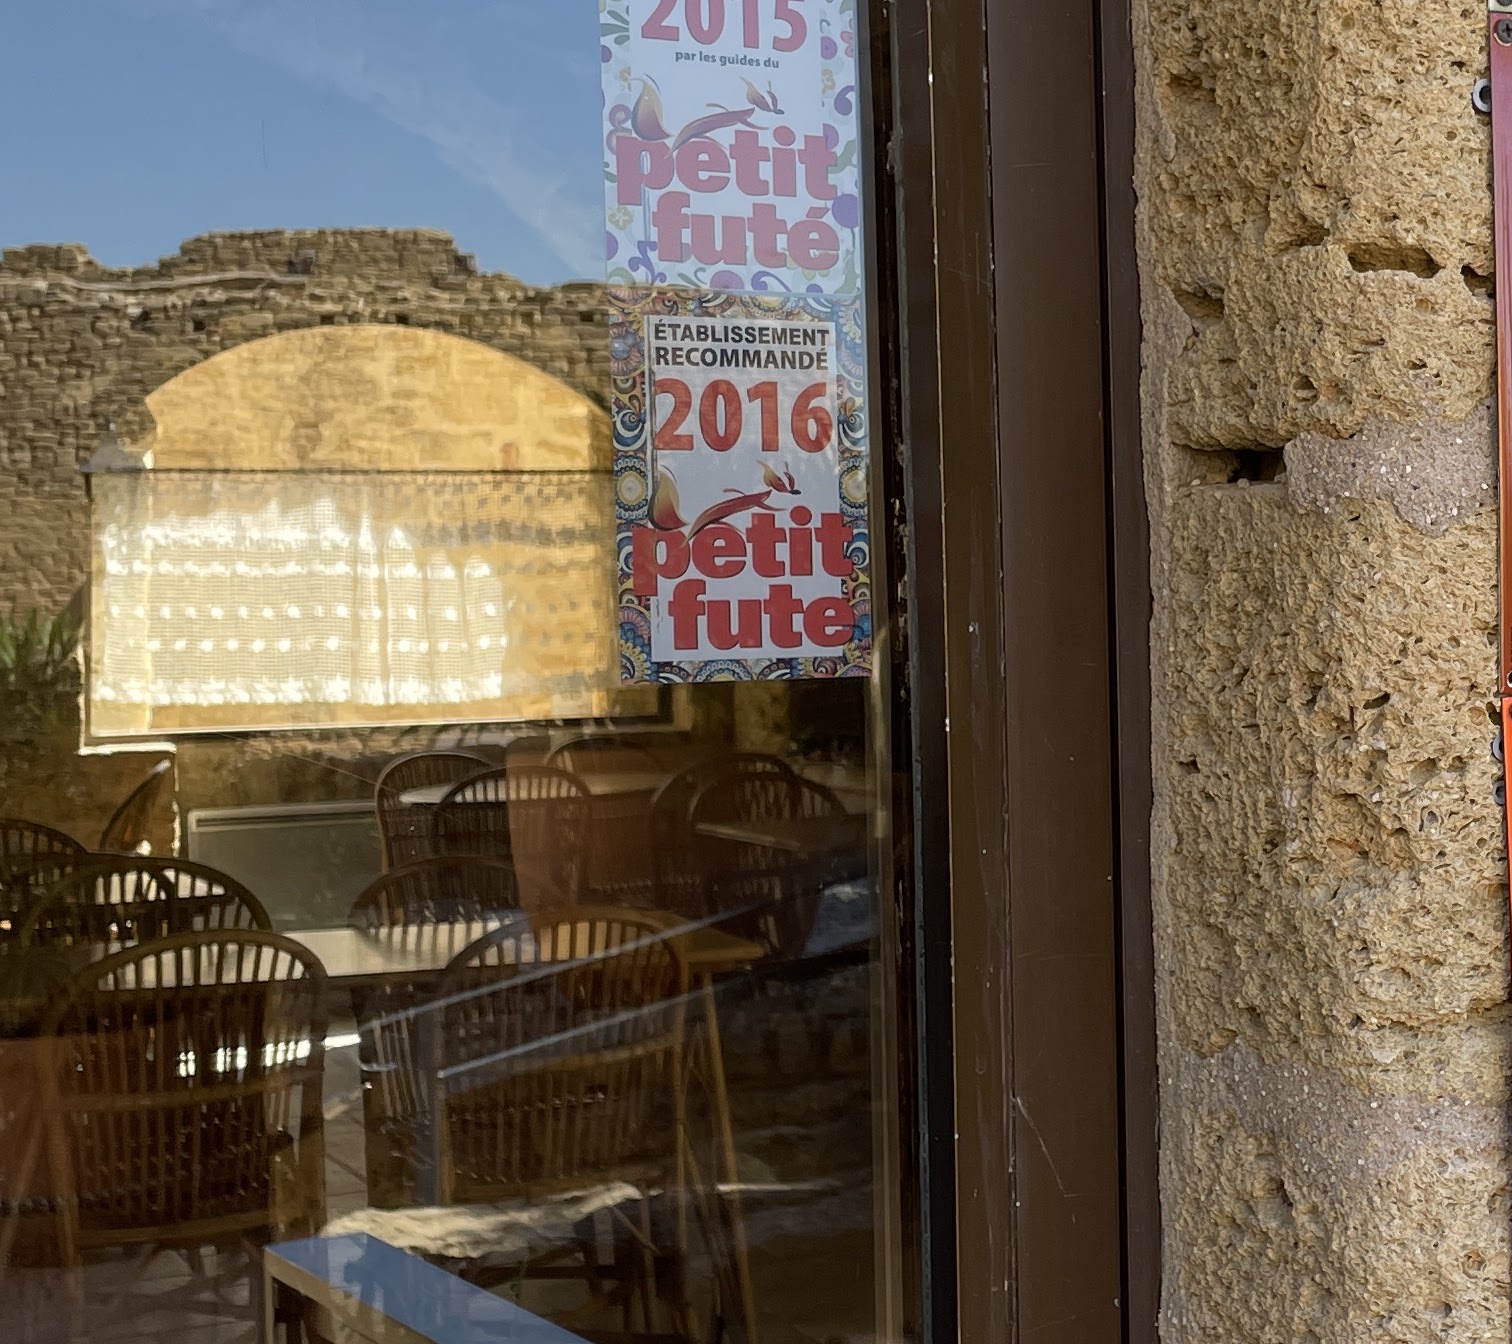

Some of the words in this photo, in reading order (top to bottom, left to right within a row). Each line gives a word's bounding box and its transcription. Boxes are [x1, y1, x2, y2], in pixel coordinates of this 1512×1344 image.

[675, 50, 697, 63] par
[699, 51, 717, 64] les
[719, 55, 761, 68] guides
[763, 57, 780, 69] du
[616, 125, 838, 206] petit
[652, 191, 840, 271] futé
[654, 319, 830, 346] ÉTABLISSEMENT
[655, 346, 828, 370] RECOMMANDÉ
[654, 378, 833, 453] 2016
[632, 505, 854, 597] petit
[668, 579, 856, 650] fute
